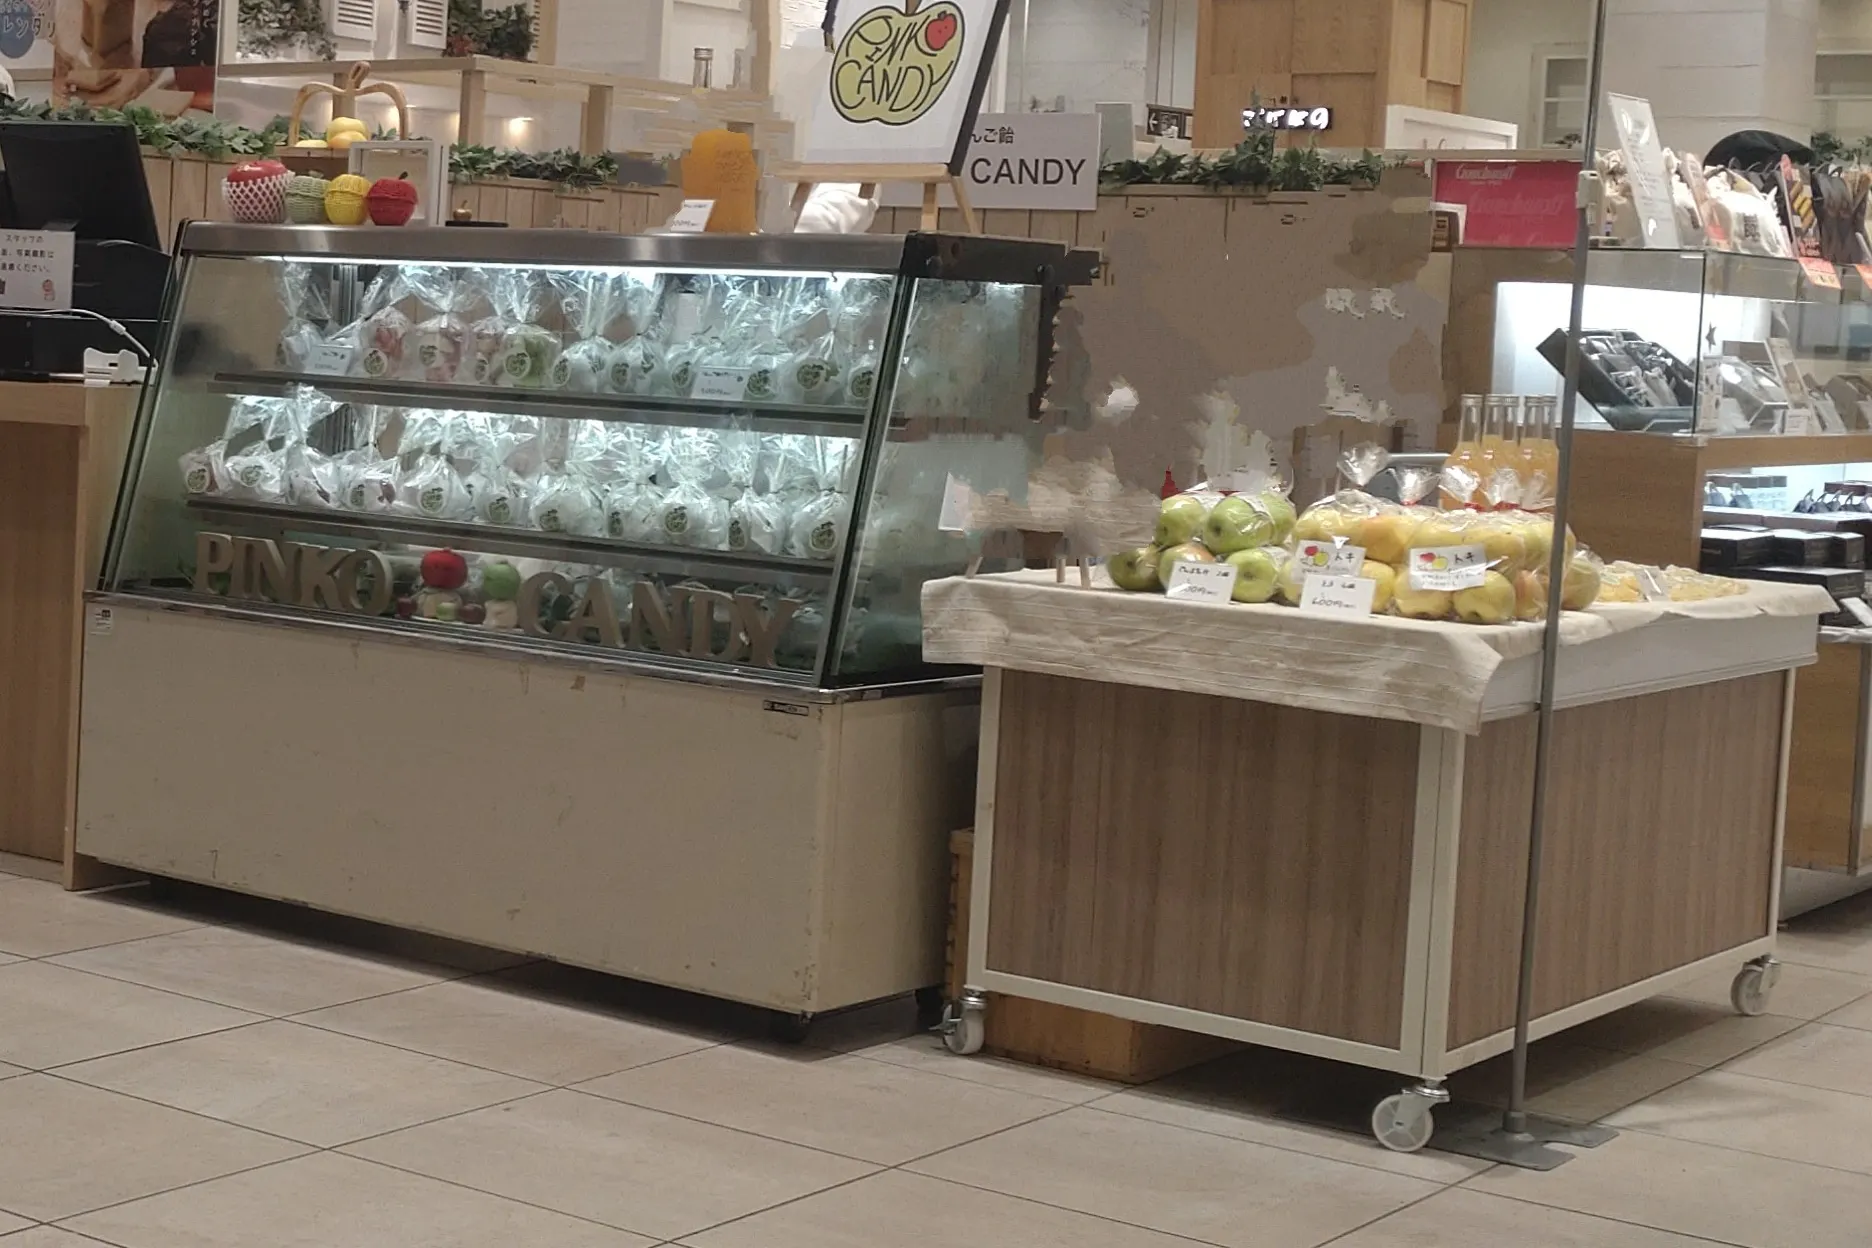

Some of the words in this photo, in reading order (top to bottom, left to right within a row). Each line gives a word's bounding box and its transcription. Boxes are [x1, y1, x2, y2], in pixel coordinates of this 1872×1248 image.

[836, 60, 954, 112] CANDY
[970, 157, 1086, 185] CANDY
[193, 531, 393, 617] PINKO
[517, 571, 803, 669] CANDY
